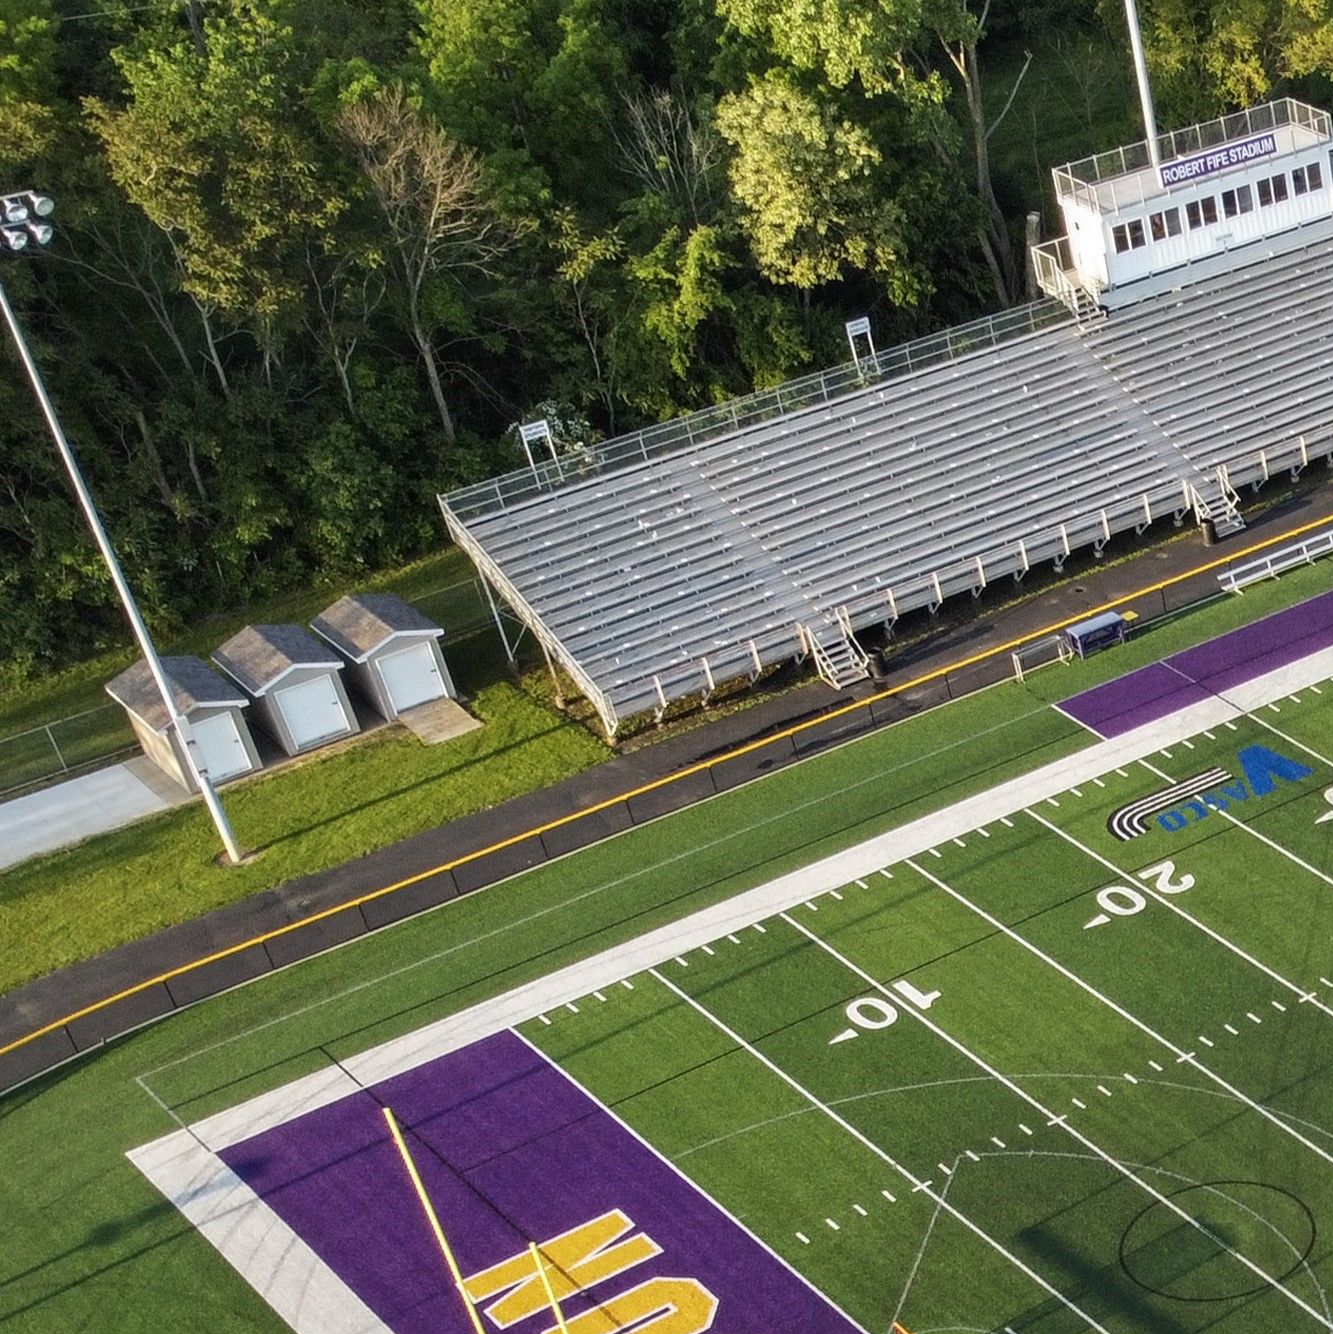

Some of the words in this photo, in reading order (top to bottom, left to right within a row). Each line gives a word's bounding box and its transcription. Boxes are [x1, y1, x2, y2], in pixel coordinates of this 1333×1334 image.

[1163, 158, 1205, 184] ROBERT
[1206, 151, 1230, 171] FIFE
[1229, 136, 1274, 163] STADIUM
[1096, 860, 1196, 916] 20
[845, 980, 942, 1030] 10
